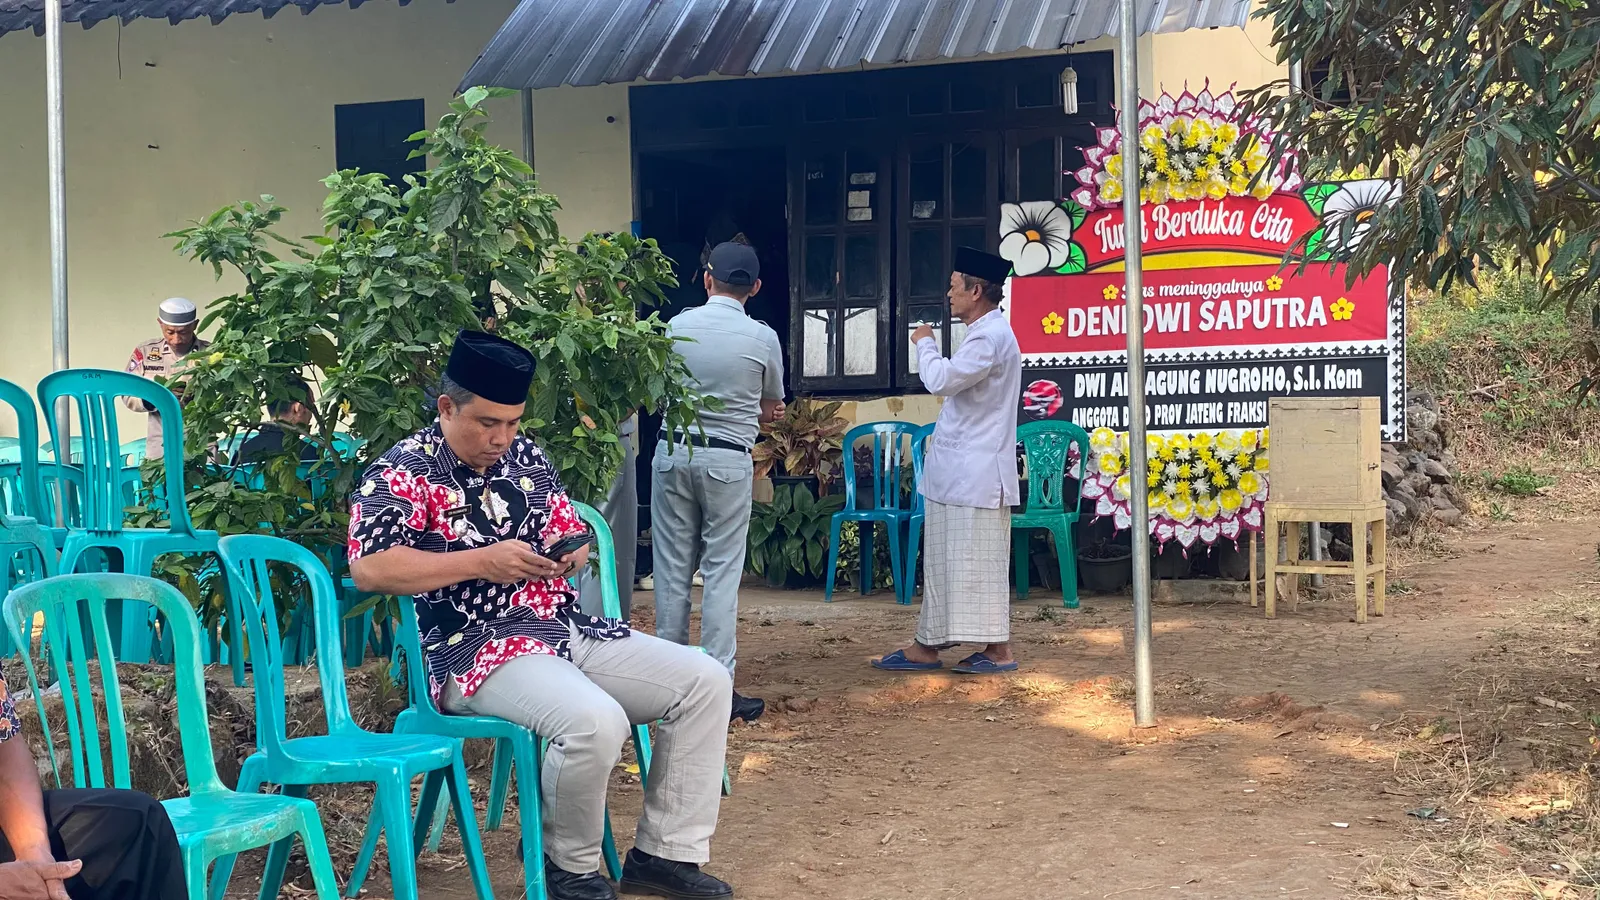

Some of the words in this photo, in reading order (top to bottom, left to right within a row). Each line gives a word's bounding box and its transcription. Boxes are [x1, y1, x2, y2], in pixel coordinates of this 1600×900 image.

[1094, 213, 1148, 253] Turt
[1152, 200, 1245, 241] Berduka
[1250, 203, 1293, 244] Cita
[1159, 280, 1264, 299] meninggalnya
[1143, 301, 1190, 333] DWI
[1199, 296, 1328, 331] SAPUTRA
[1074, 372, 1106, 398] DWI
[1145, 369, 1201, 396] AGUNG
[1072, 406, 1119, 428] ANGGOTA
[1154, 403, 1183, 425] PROV
[1185, 402, 1224, 424] JATENG
[1227, 401, 1267, 423] FRAKSI
